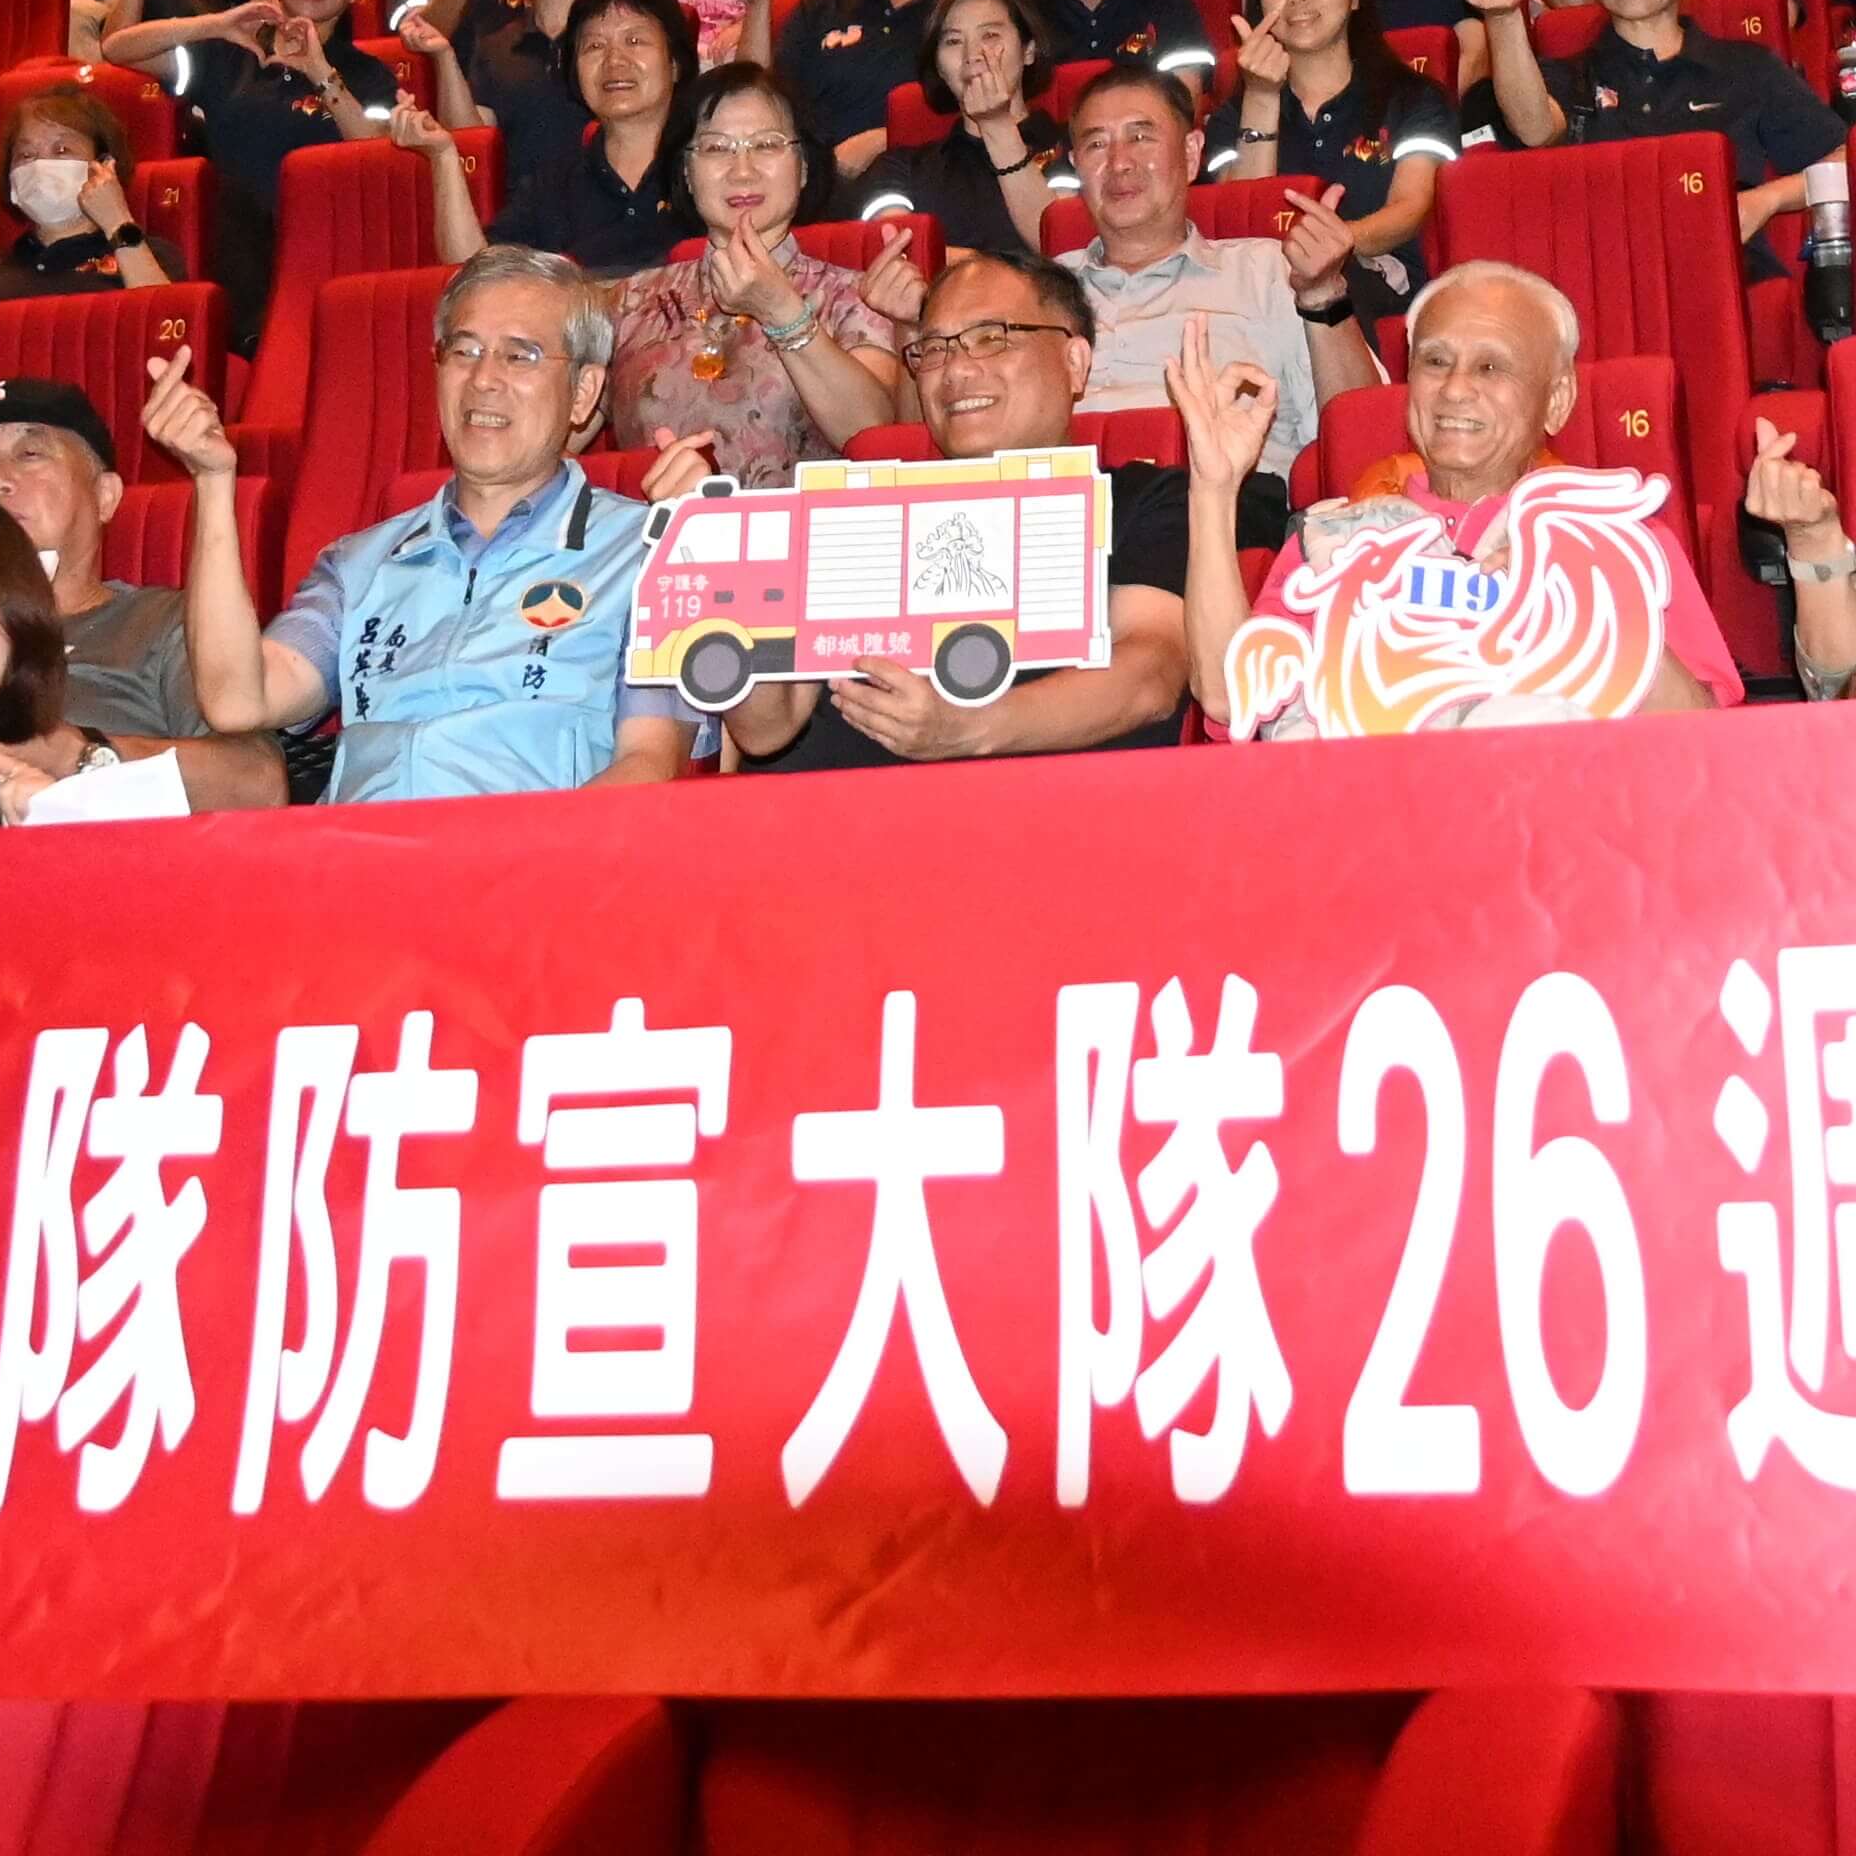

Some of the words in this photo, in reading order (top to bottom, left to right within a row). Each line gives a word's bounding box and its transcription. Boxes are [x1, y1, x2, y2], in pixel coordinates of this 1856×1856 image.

[1741, 16, 1763, 37] 16
[1679, 172, 1705, 196] 16
[160, 185, 182, 208] 21
[1272, 210, 1296, 234] 17
[158, 317, 188, 341] 20
[1618, 408, 1651, 438] 16
[656, 573, 711, 593] 守護者
[1408, 563, 1500, 612] 119
[659, 594, 702, 619] 119
[812, 629, 913, 659] 都城隍號
